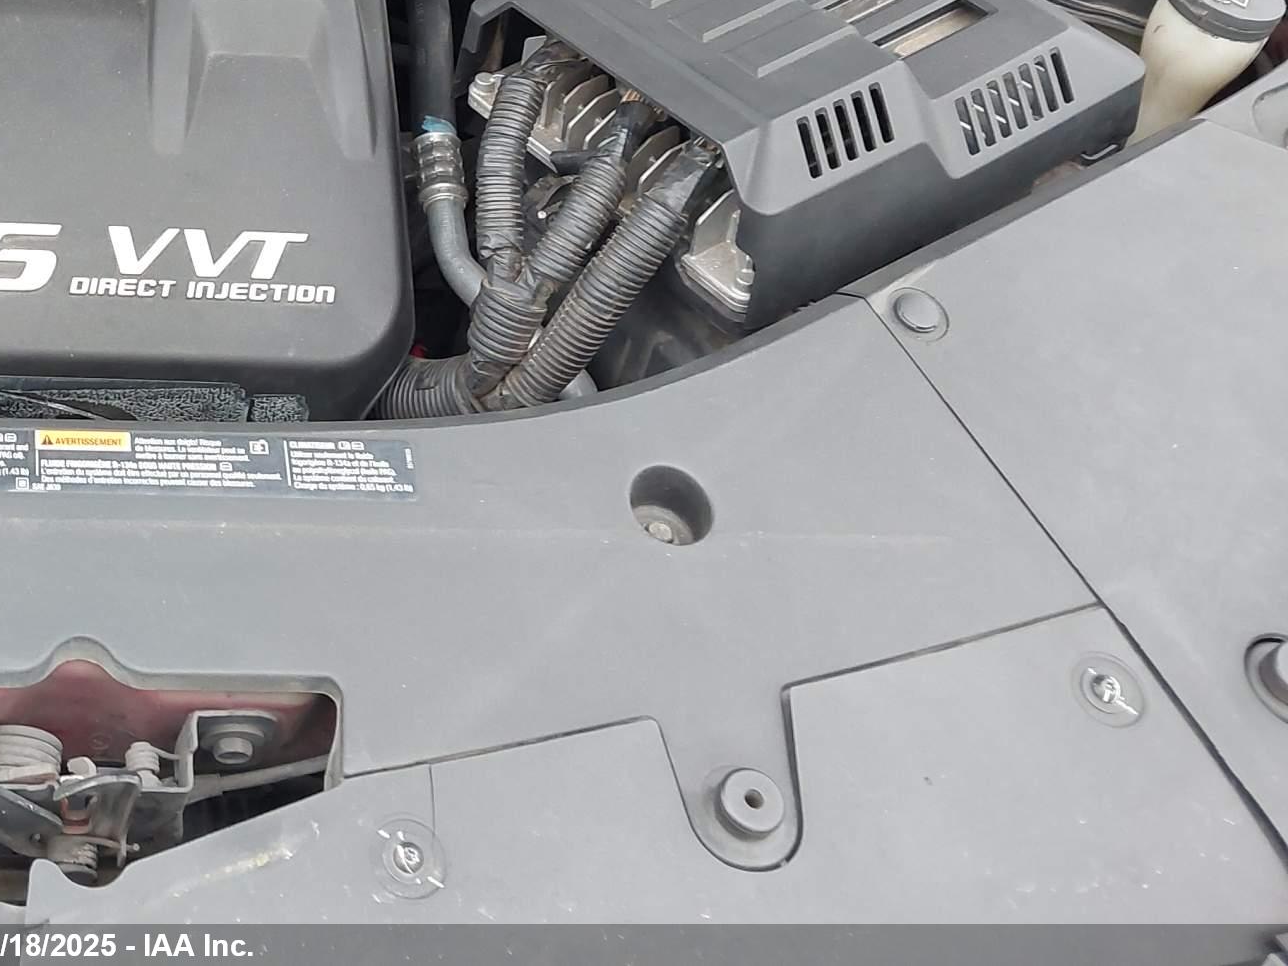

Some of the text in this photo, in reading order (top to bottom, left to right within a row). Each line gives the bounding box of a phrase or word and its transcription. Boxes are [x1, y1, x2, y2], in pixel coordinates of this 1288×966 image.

[107, 225, 310, 280] VVT
[68, 276, 335, 304] DIRECT INJECTION
[55, 437, 122, 447] AVERTISSEMENT
